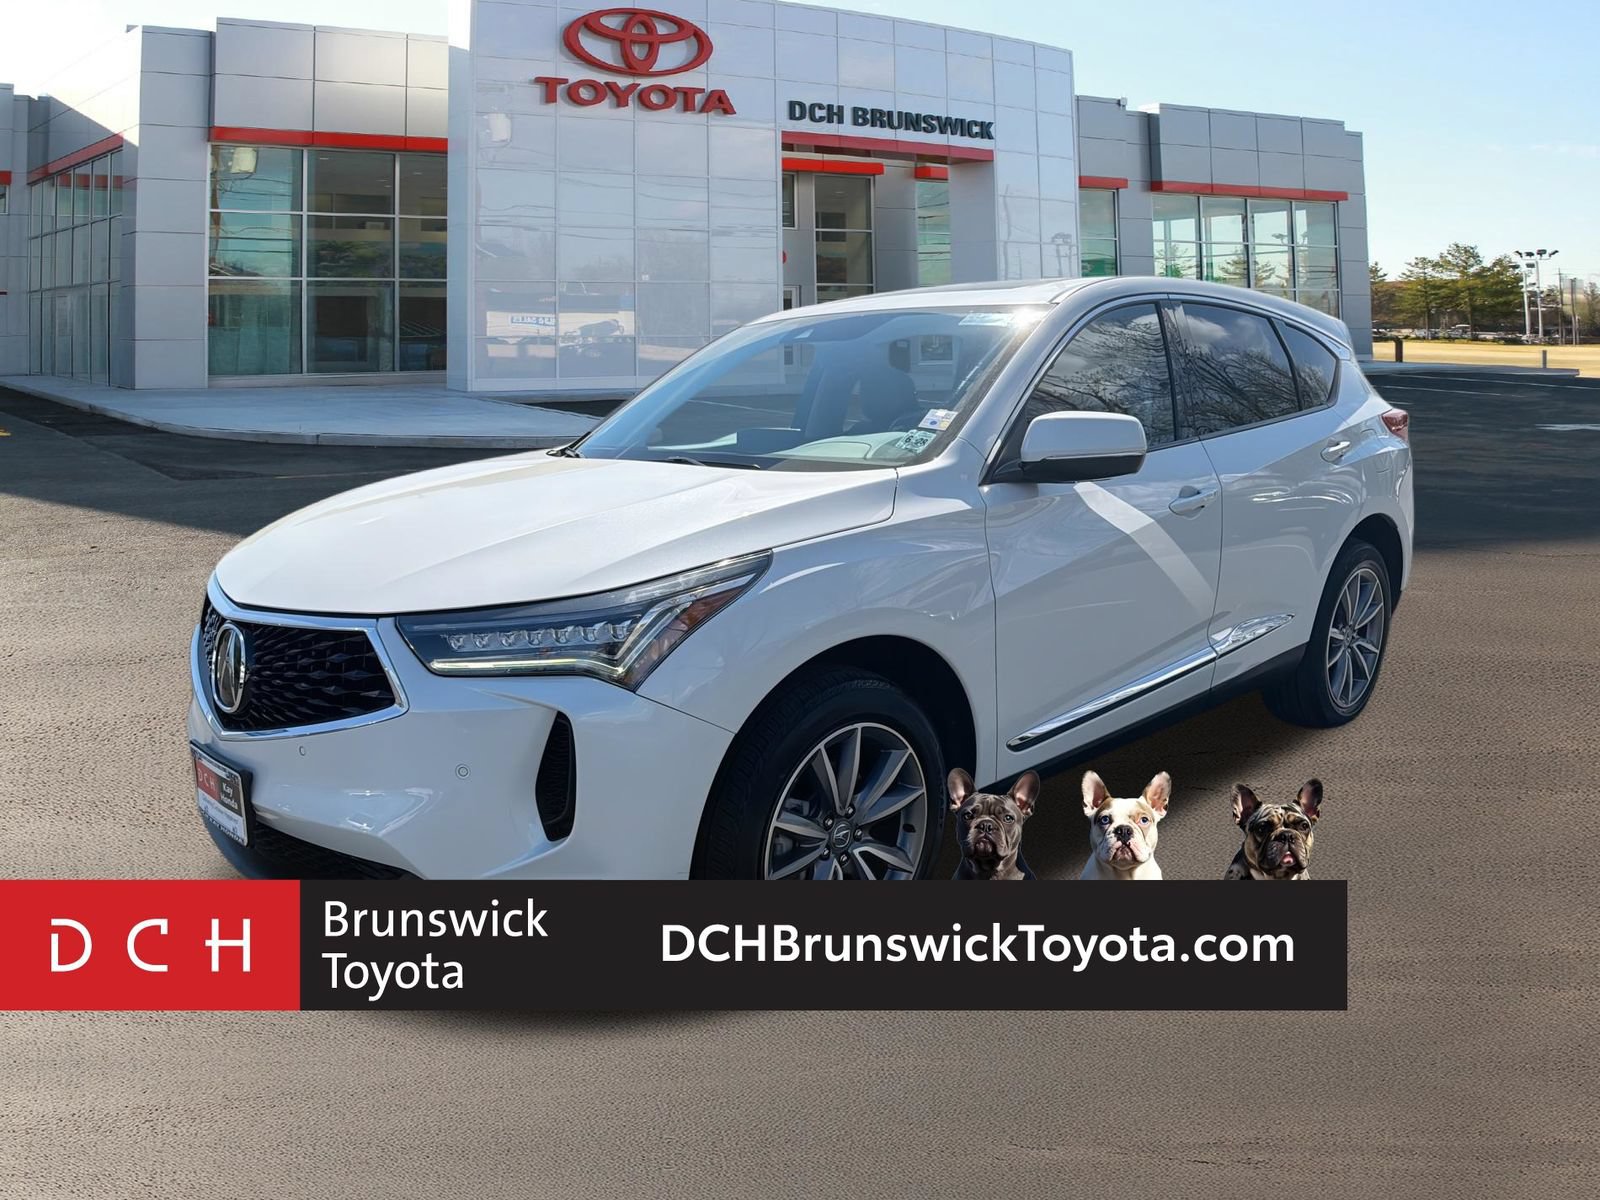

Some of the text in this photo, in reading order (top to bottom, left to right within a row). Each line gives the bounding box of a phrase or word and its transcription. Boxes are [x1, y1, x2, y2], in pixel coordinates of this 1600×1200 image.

[534, 75, 736, 116] TOYOTA
[788, 99, 995, 140] DCH BRUNSWICK
[197, 768, 217, 793] DCH
[222, 782, 233, 797] Kay
